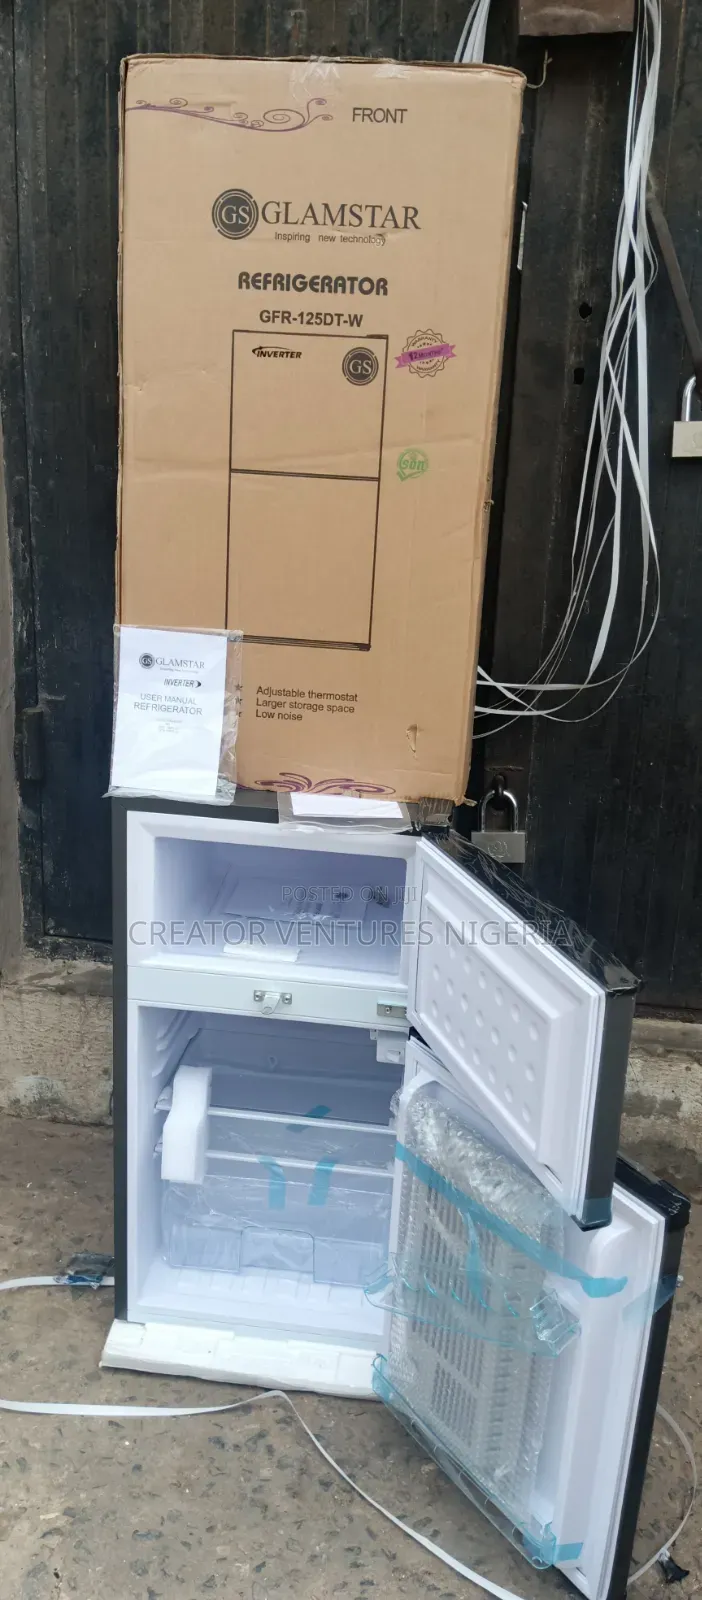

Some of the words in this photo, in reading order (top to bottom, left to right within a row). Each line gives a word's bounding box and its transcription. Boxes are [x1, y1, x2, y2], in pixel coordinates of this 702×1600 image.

[352, 107, 408, 124] FRONT
[221, 204, 250, 225] GS
[261, 200, 421, 229] GLAMSTAR
[274, 231, 311, 243] Inspiring
[318, 234, 336, 243] new
[340, 234, 386, 246] technology
[238, 271, 388, 296] REFRIGERATOR
[259, 309, 363, 328] GFR-125DT-W
[256, 350, 302, 359] INVERTER
[349, 359, 372, 375] GS
[155, 657, 205, 669] GLAMSTAR
[163, 678, 195, 688] INVERTER
[140, 693, 163, 702] USER
[164, 695, 197, 705] MANUAL
[256, 686, 306, 699] Adjustable
[307, 690, 358, 702] thermostat
[133, 701, 203, 716] REFRIGERATOR
[256, 698, 286, 710] Larger
[289, 701, 325, 713] storage
[326, 703, 355, 714] space
[255, 709, 276, 719] Low
[277, 711, 303, 721] noise
